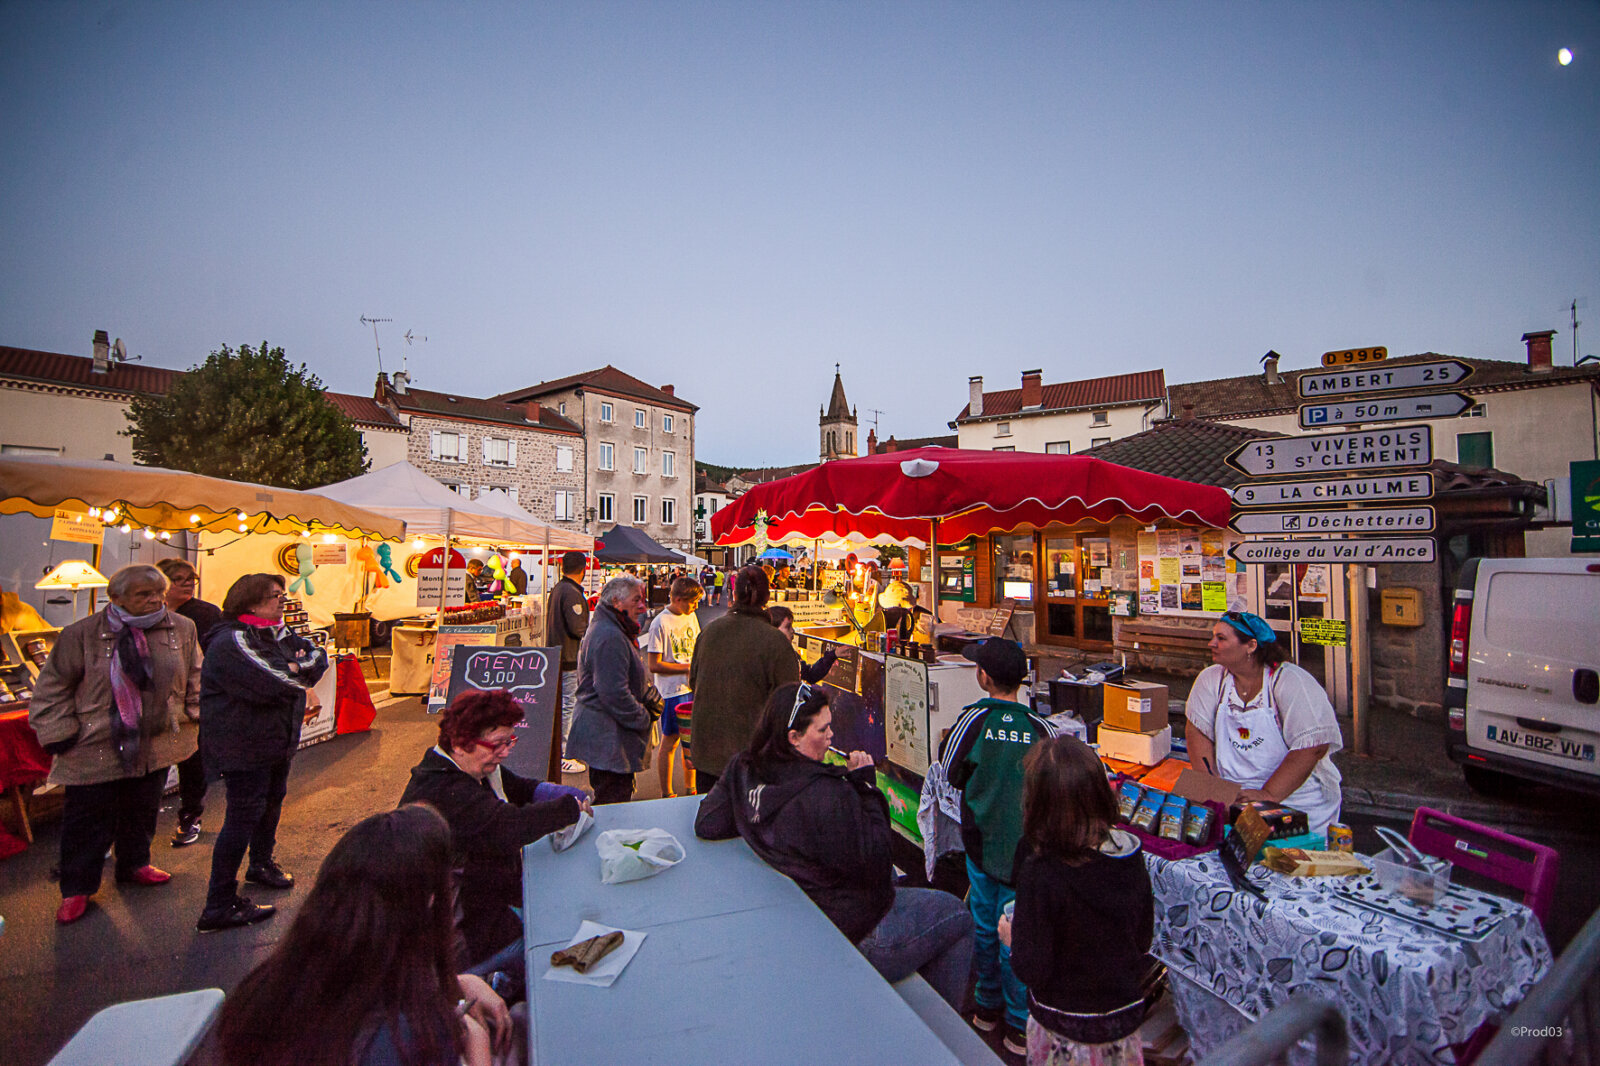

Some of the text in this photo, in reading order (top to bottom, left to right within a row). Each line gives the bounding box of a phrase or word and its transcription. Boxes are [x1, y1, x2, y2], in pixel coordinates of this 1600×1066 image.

[1326, 348, 1383, 365] D 996
[1308, 367, 1450, 392] AMBERT 25
[1334, 407, 1344, 420] à
[1354, 404, 1379, 418] 50
[1383, 405, 1399, 416] m
[1255, 432, 1422, 457] 13 VIVEROLS
[1265, 458, 1275, 470] 3
[1321, 447, 1421, 466] CLÉMENT
[1245, 479, 1420, 501] 9 LA CHAULME
[1307, 513, 1425, 528] Déchetterie
[1246, 546, 1301, 561] collège
[1306, 545, 1326, 558] du
[1333, 544, 1358, 558] Val
[474, 655, 541, 671] MENU
[481, 671, 516, 686] 9,00
[984, 728, 1032, 744] A.S.S.E
